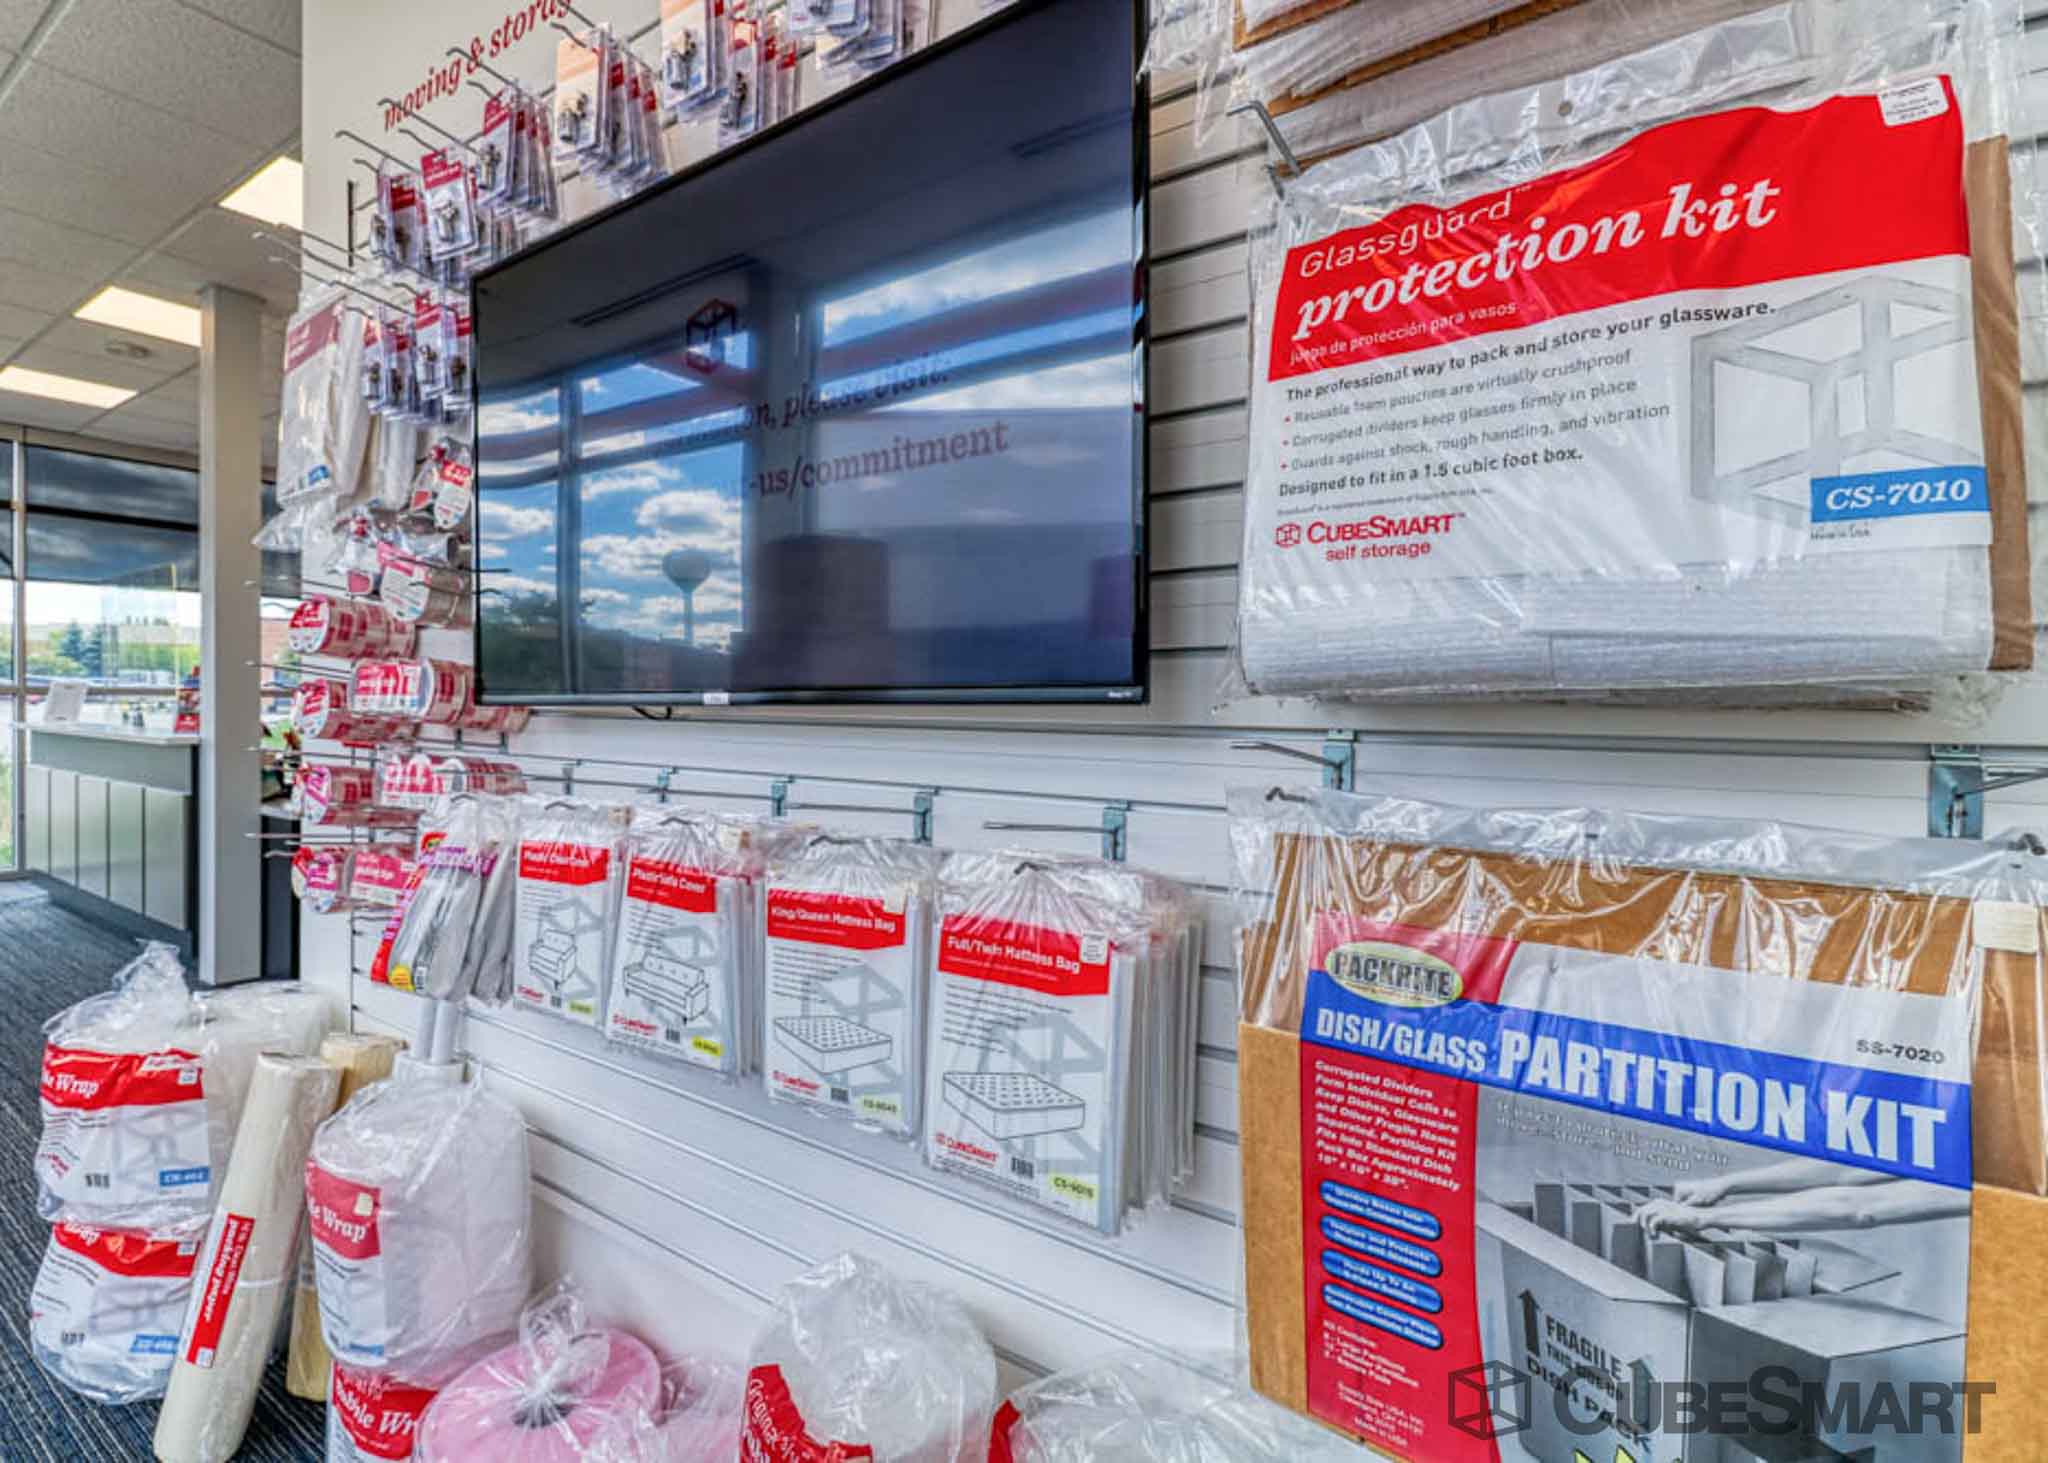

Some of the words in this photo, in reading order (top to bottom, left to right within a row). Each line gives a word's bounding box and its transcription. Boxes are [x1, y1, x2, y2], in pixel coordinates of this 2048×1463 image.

[384, 57, 461, 132] moving
[1292, 205, 1646, 340] protection
[1660, 178, 1781, 240] kit
[1300, 191, 1512, 279] Glassguard
[1287, 387, 1311, 402] The
[1315, 367, 1410, 398] professional
[1413, 361, 1446, 379] way
[1450, 356, 1465, 370] to
[1470, 343, 1510, 367] pack
[1514, 339, 1548, 356] and
[1552, 326, 1601, 348] store
[1606, 314, 1654, 340] your
[1660, 300, 1776, 330] glassware.
[1330, 337, 1348, 354] de
[1350, 322, 1427, 354] protección
[1431, 312, 1464, 336] para
[1468, 303, 1517, 321] vasos
[1450, 383, 1474, 396] are
[1477, 366, 1538, 393] virtually
[1542, 348, 1632, 380] crushproof
[1292, 424, 1363, 447] Corrugated
[1459, 400, 1515, 422] glasses
[1519, 388, 1566, 411] firmly
[1571, 385, 1587, 401] in
[1591, 378, 1638, 400] place
[1437, 431, 1479, 451] rough
[1558, 415, 1589, 432] and
[1593, 403, 1671, 427] vibration
[1279, 475, 1346, 497] Designed
[1350, 475, 1366, 488] to
[1369, 470, 1386, 485] fit
[1389, 468, 1406, 482] in
[1409, 469, 1420, 480] a
[1424, 462, 1449, 478] 1.5
[1452, 456, 1499, 476] cubic
[1503, 449, 1540, 469] foot
[1543, 446, 1584, 464] box.
[1826, 479, 1971, 510] CS-7010
[1307, 514, 1457, 545] CUBESMART
[1326, 541, 1357, 562] self
[1361, 540, 1432, 562] storage
[1055, 956, 1080, 975] Bag
[1855, 1039, 1945, 1064] SS-7020
[1316, 1007, 1487, 1073] DISH/GLASS
[1500, 1028, 1806, 1144] PARTITION
[1826, 1089, 1947, 1170] KIT
[322, 1205, 368, 1244] Wrap
[1545, 1314, 1624, 1382] FRAGILE
